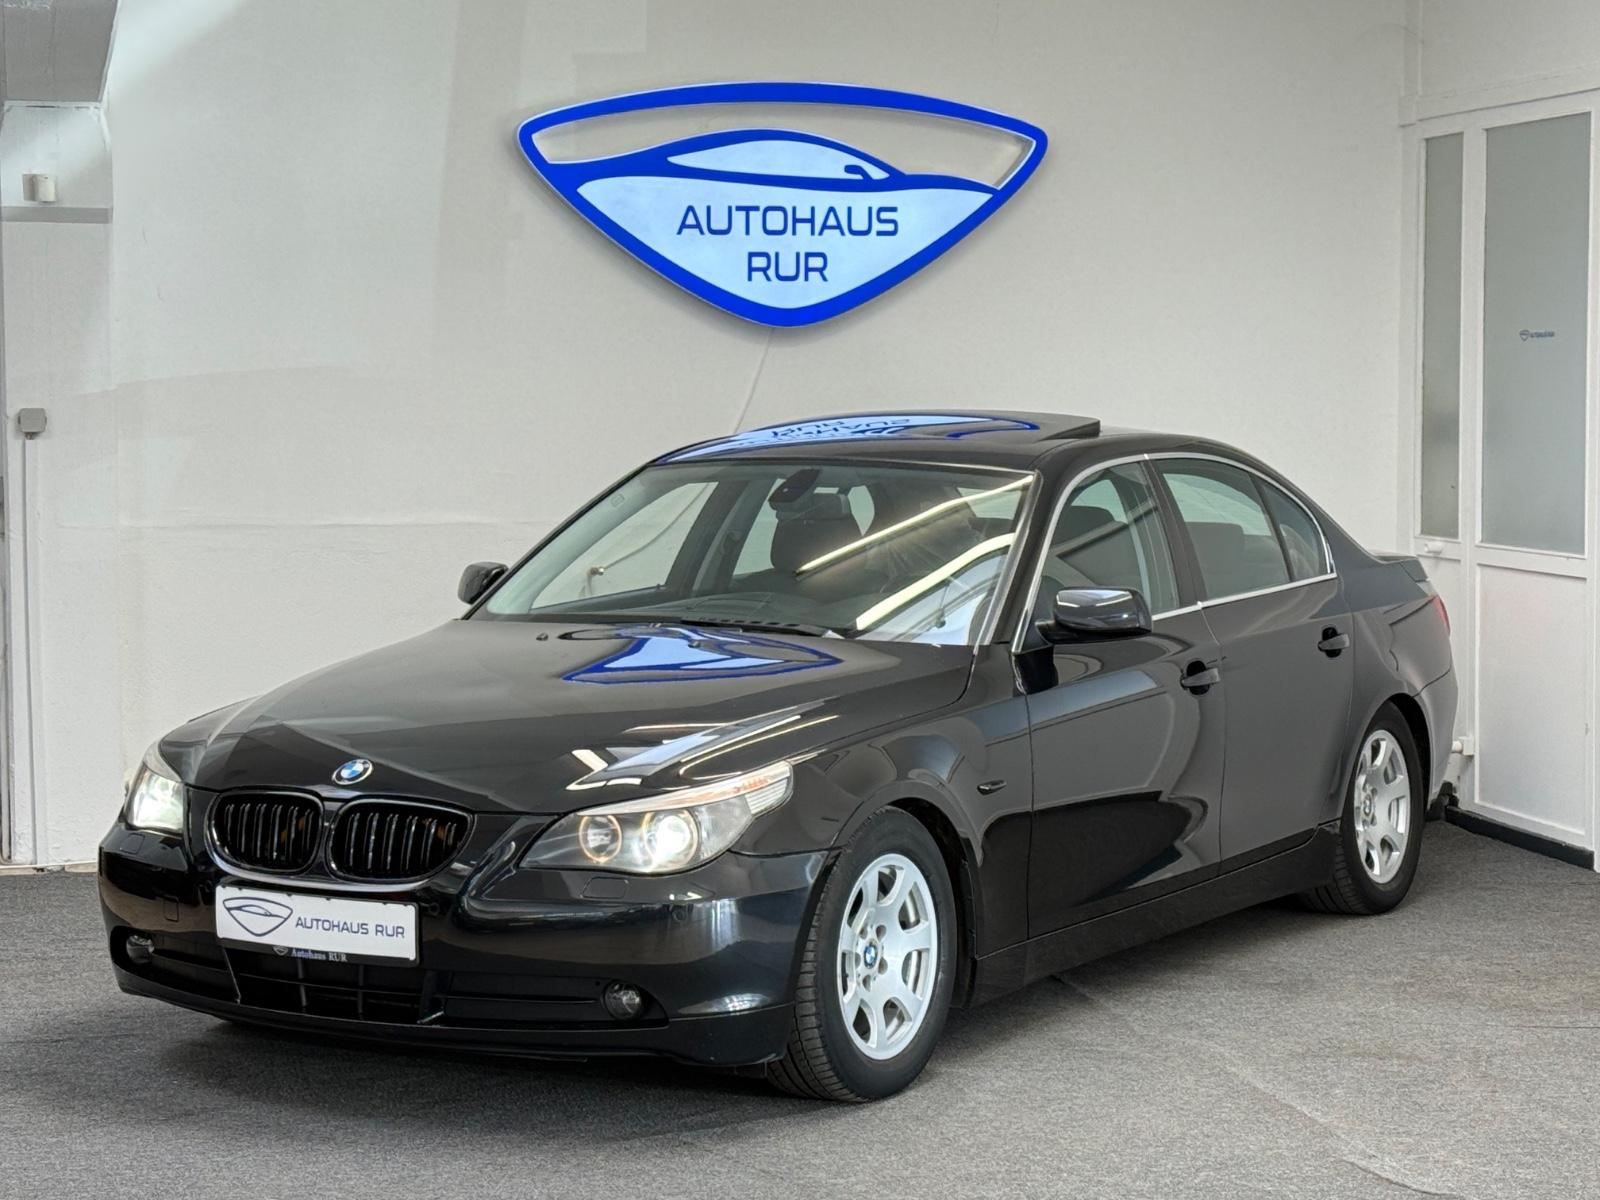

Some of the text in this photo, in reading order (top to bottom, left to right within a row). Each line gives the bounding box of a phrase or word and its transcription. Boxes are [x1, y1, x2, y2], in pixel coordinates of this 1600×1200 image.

[677, 205, 898, 237] AUTOHAUS
[747, 251, 828, 282] RUR
[295, 916, 405, 938] AUTOHAUS RUR
[291, 947, 348, 962] Autohaus RUR
